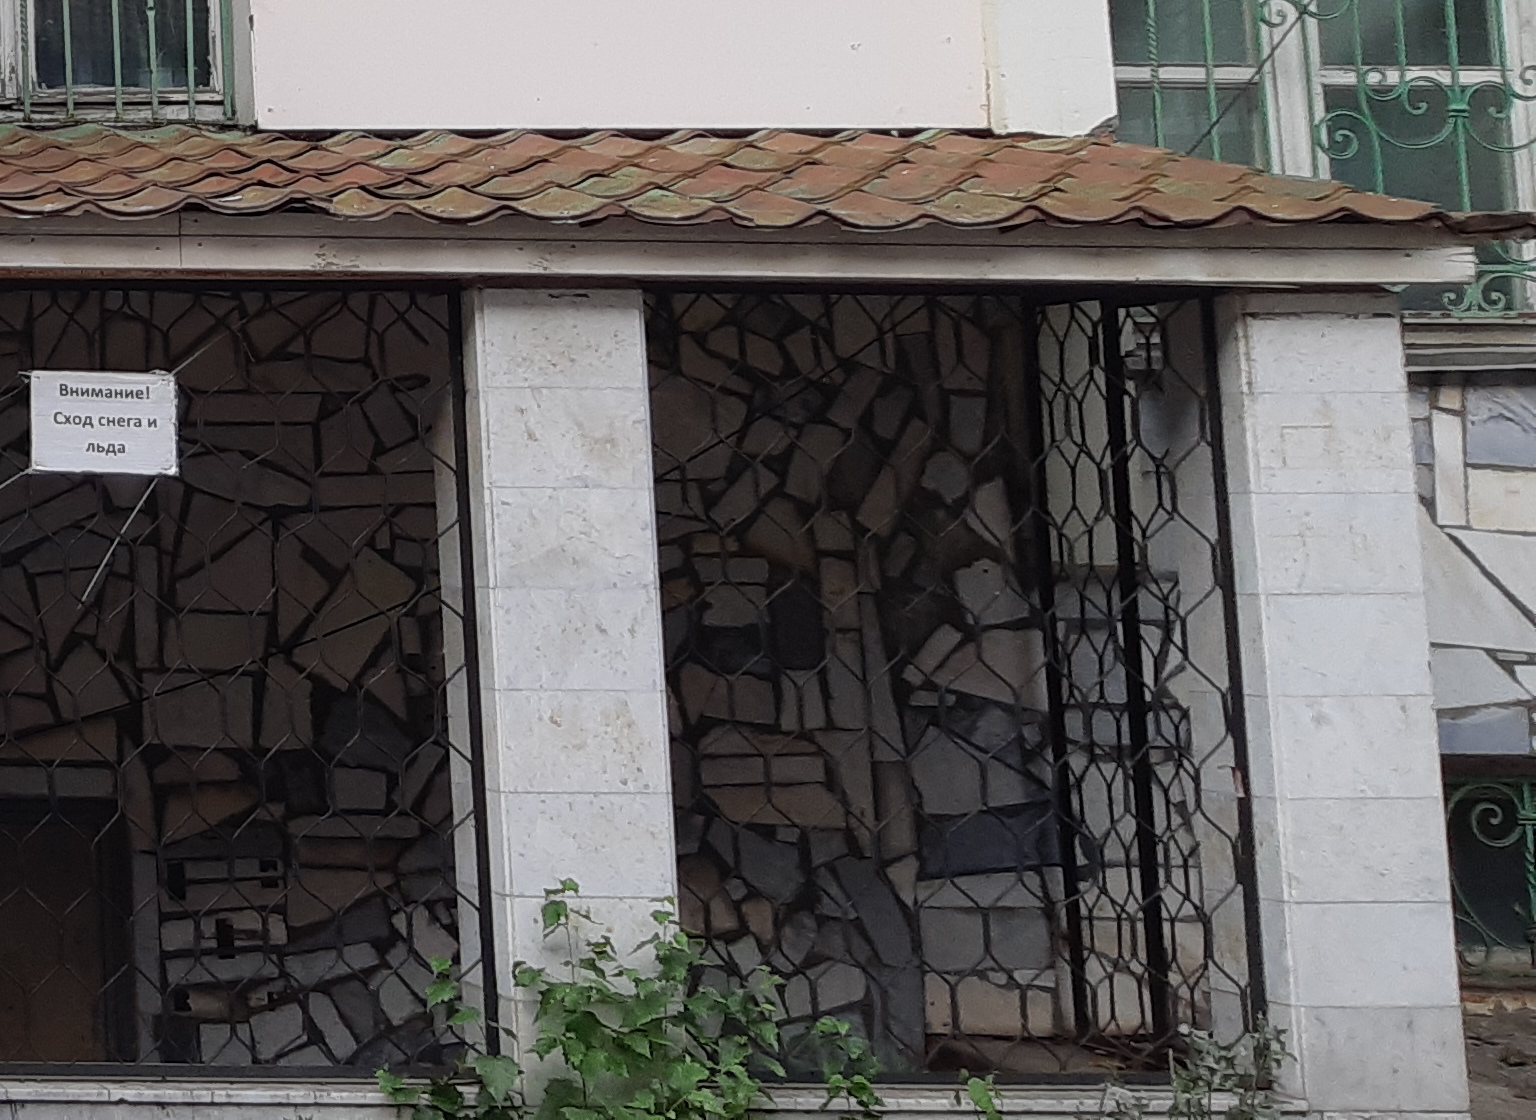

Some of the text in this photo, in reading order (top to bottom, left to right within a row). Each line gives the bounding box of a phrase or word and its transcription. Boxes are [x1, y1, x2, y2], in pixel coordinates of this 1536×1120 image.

[59, 383, 150, 400] Внимание!
[53, 411, 158, 429] Сход снега и
[85, 442, 126, 457] льда
